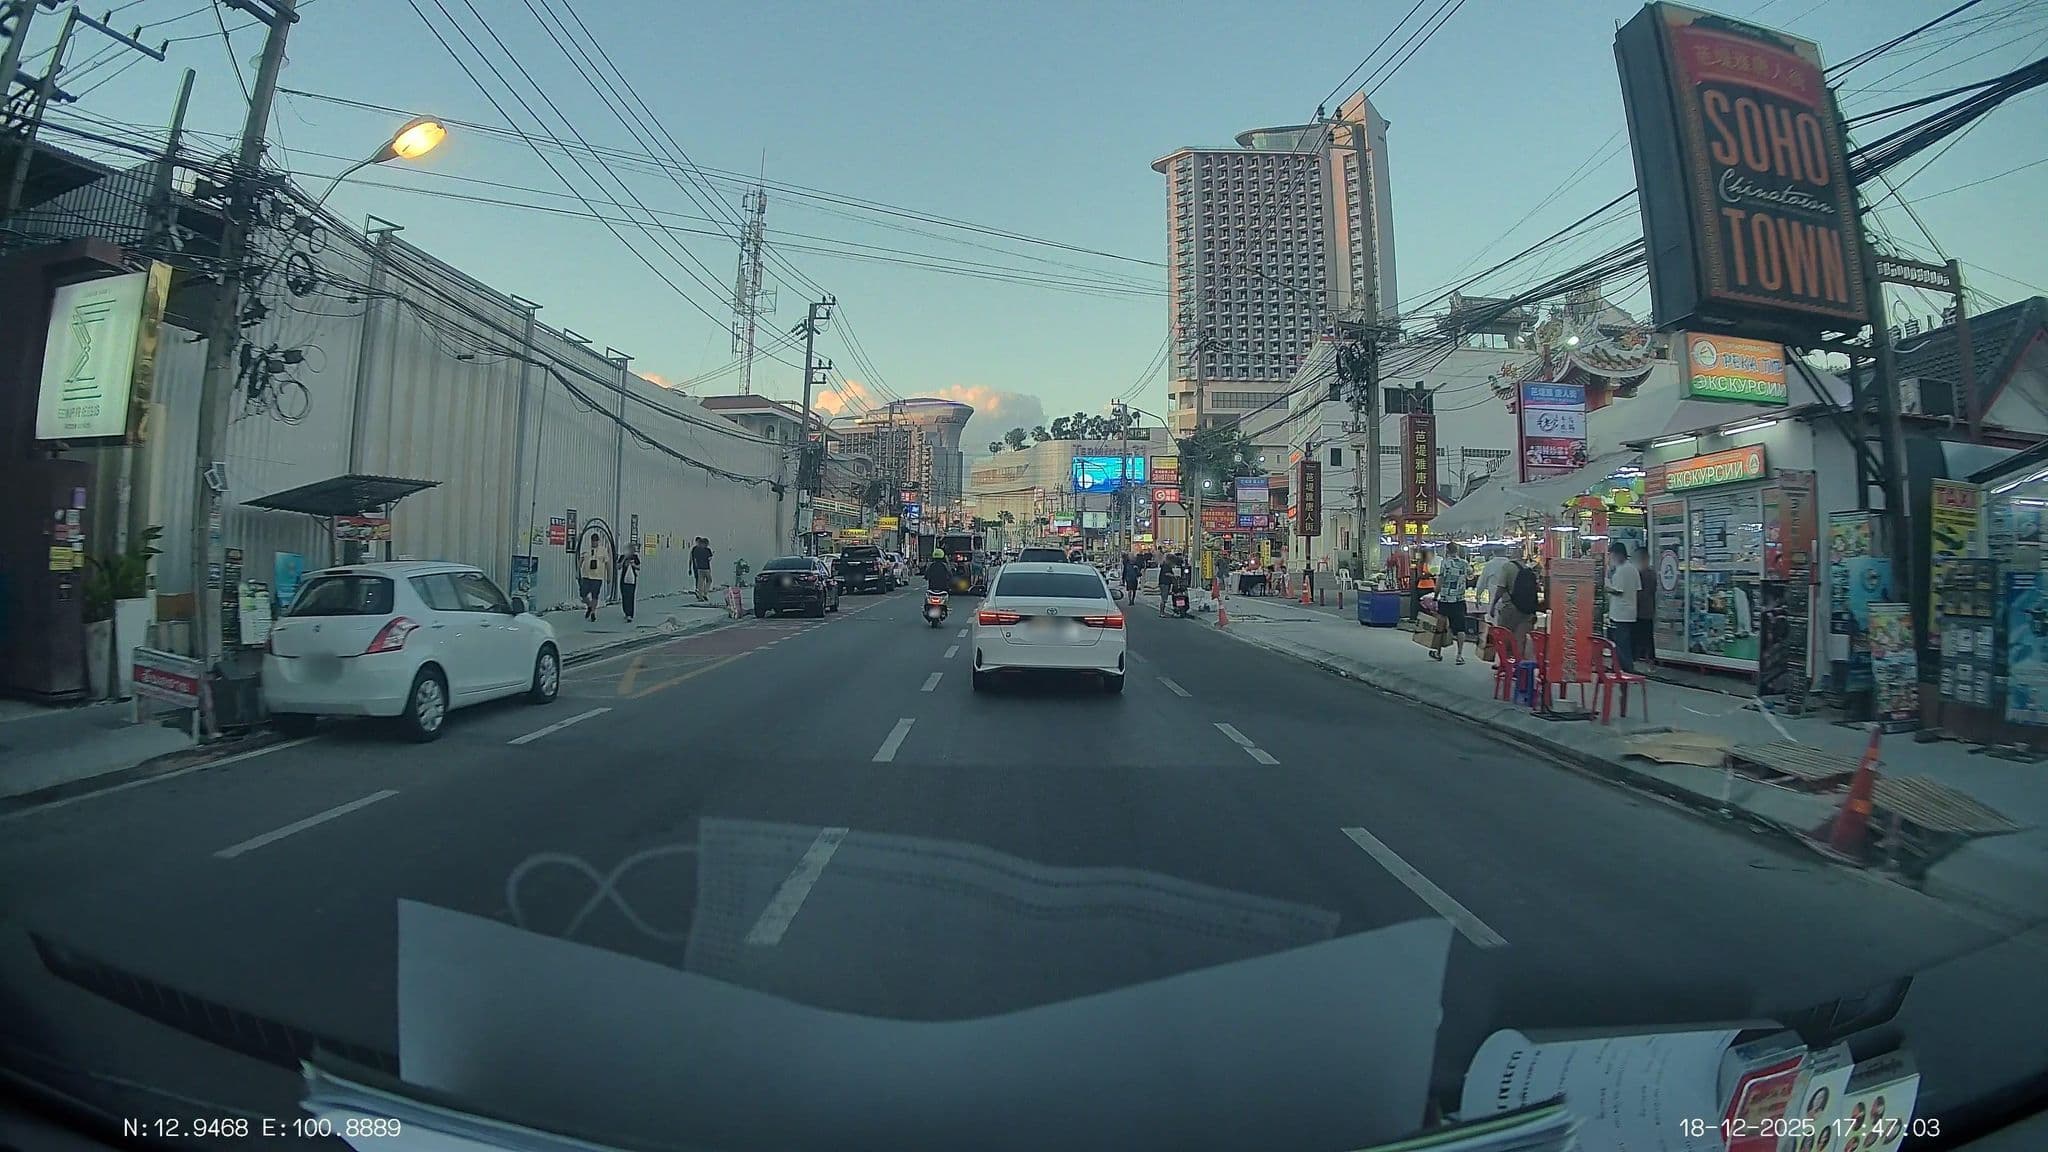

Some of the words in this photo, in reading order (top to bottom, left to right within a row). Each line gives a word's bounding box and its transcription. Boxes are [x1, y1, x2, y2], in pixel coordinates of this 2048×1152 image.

[1703, 89, 1830, 187] SOHO
[1718, 167, 1836, 215] Chinatown
[1721, 206, 1849, 304] TOWN
[1692, 374, 1787, 397] ЭКСКУРСИИ
[1414, 430, 1428, 513] 芭堤雅唐人街
[1666, 460, 1744, 490] ЭКСКУРСИИ
